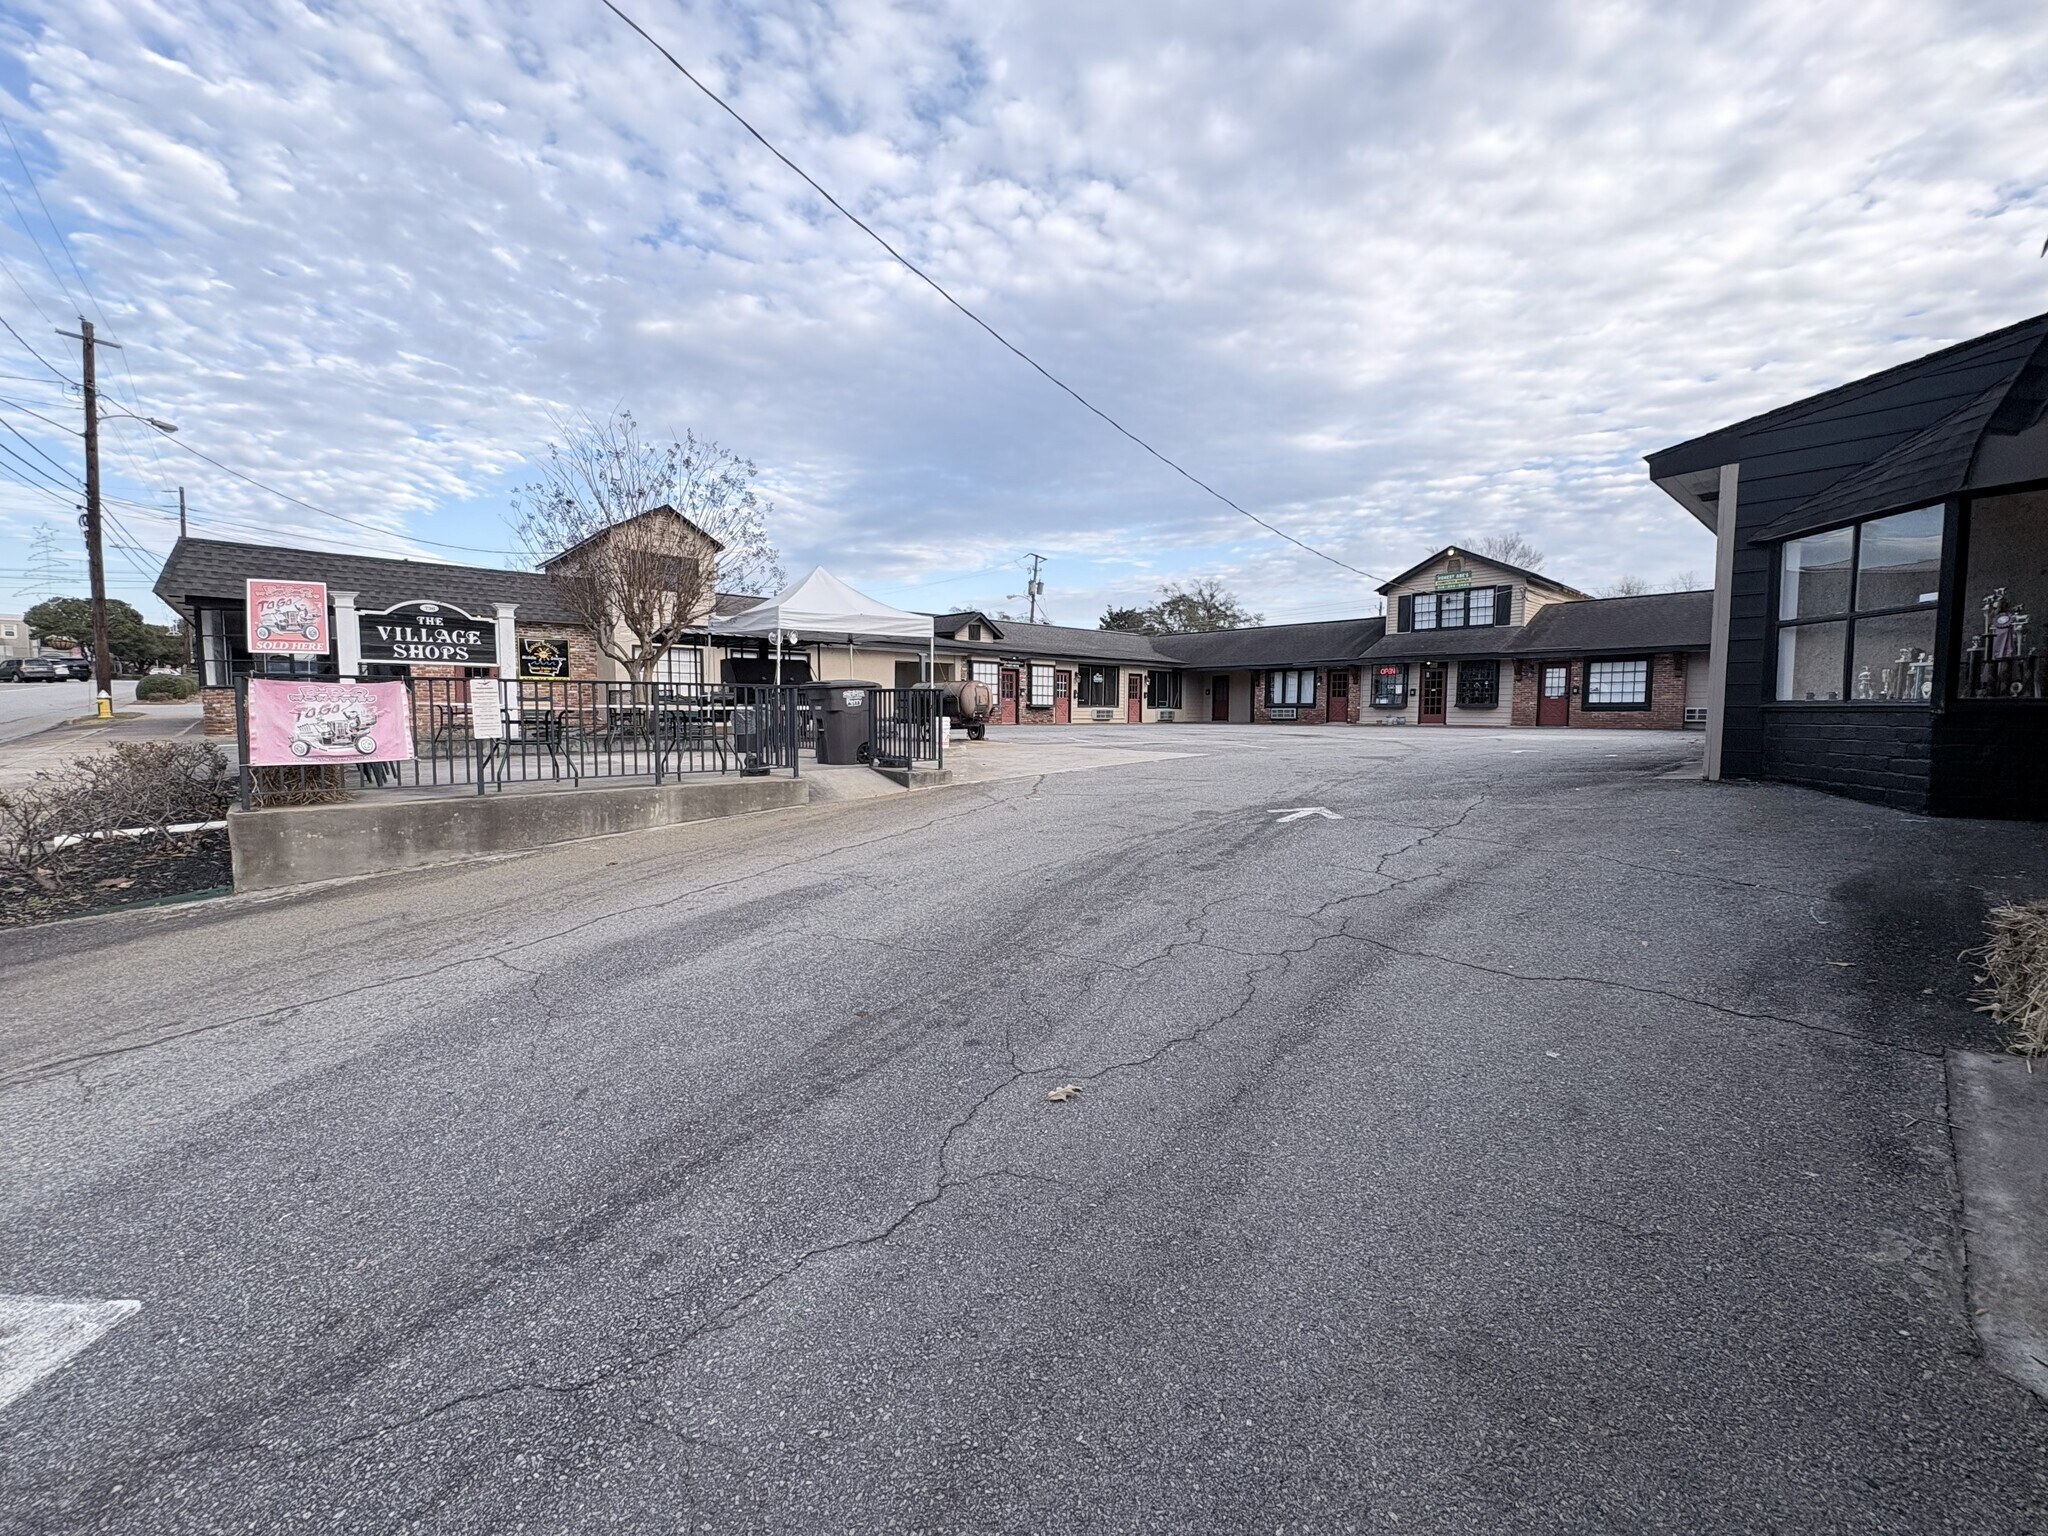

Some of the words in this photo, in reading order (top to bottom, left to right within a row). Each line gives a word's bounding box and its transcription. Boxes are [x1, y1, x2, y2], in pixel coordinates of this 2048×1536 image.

[416, 616, 444, 626] THE
[376, 625, 481, 645] VILLAGE
[256, 641, 289, 650] SOLD
[291, 642, 324, 651] HERE
[393, 643, 470, 660] SHOPS
[1380, 667, 1396, 675] OPEN
